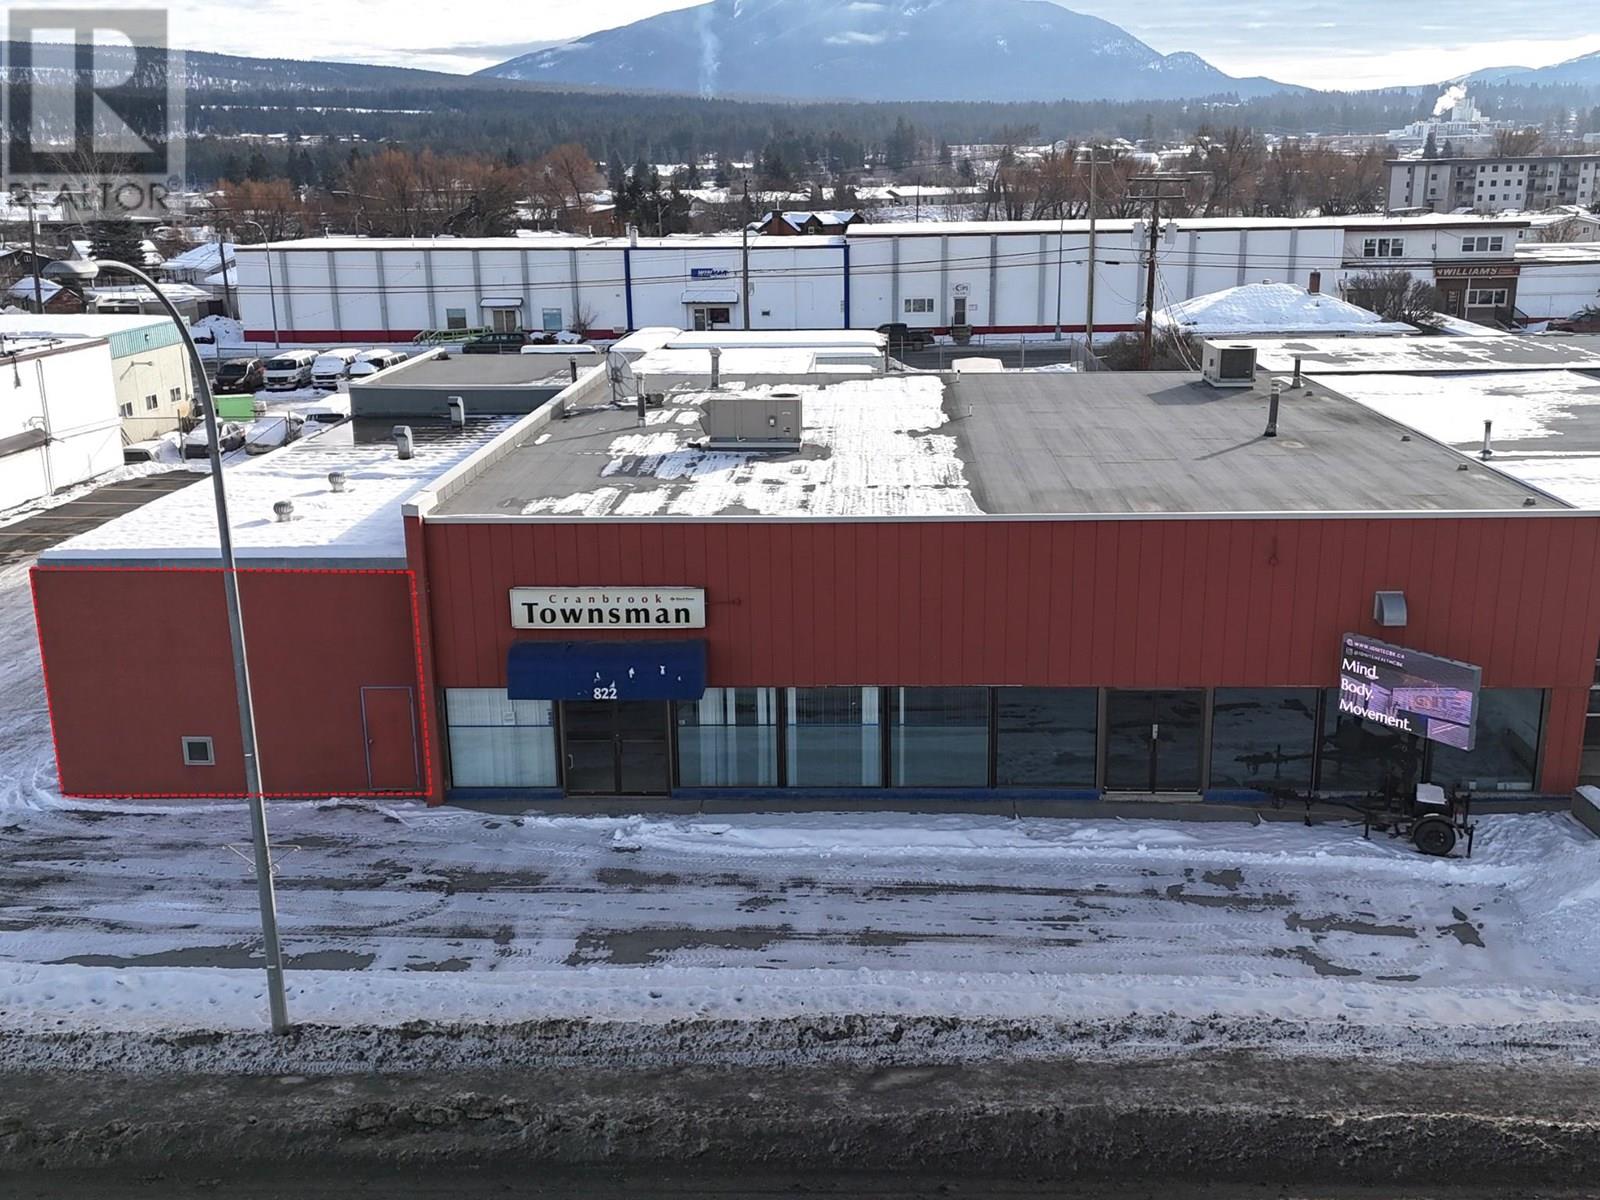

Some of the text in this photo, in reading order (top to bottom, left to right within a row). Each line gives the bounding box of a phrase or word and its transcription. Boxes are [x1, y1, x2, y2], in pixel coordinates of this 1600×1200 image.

[549, 594, 662, 604] Cranbrook
[521, 602, 690, 624] Townsman
[593, 687, 618, 699] 822
[1341, 679, 1374, 700] Body.
[1339, 698, 1412, 731] Movement.
